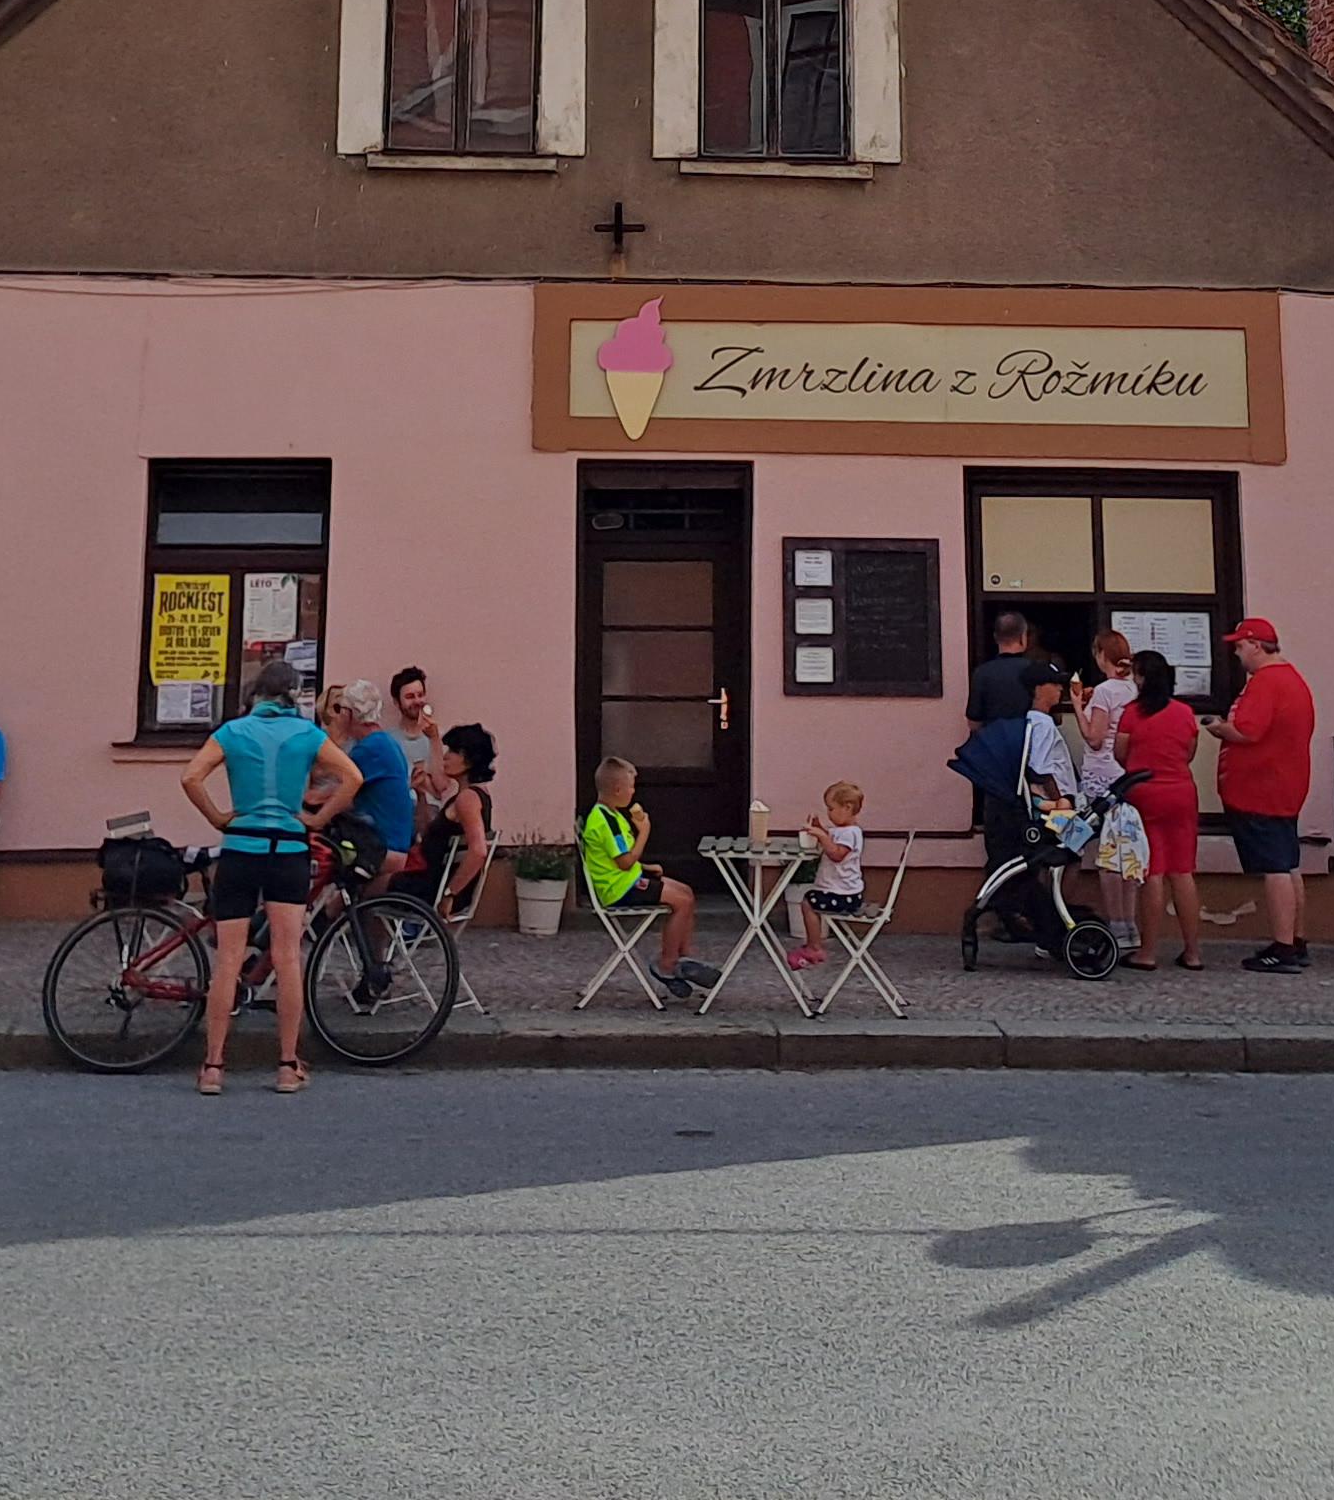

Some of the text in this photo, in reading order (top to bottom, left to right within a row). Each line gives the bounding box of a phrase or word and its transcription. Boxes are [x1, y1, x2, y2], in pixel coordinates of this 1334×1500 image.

[692, 346, 942, 399] Zmrzlina
[949, 369, 978, 396] z
[158, 591, 225, 618] ROCKFEST
